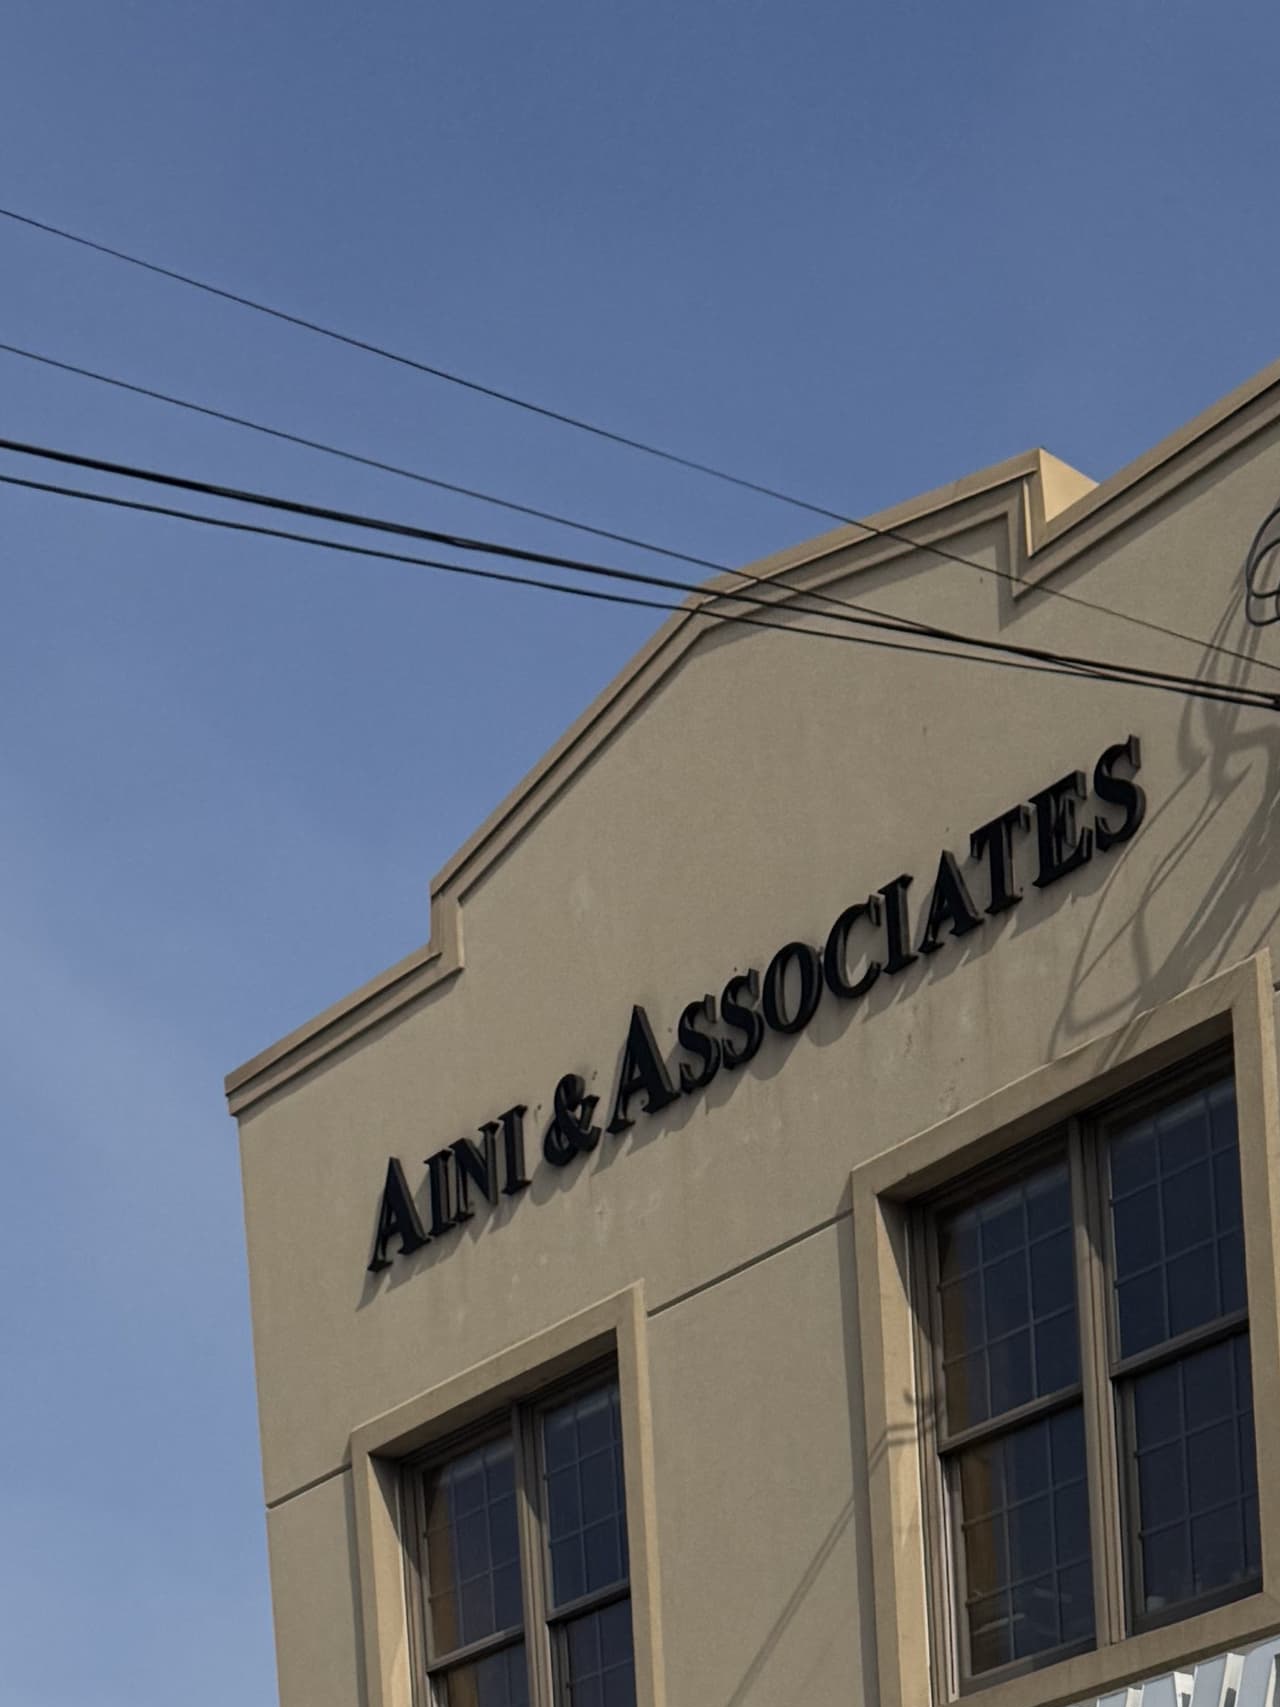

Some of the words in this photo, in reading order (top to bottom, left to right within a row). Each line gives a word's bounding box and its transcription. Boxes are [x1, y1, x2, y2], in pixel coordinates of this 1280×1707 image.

[367, 1104, 531, 1273] AINI
[542, 1073, 602, 1168] &
[606, 734, 1148, 1135] ASSOCIATES
